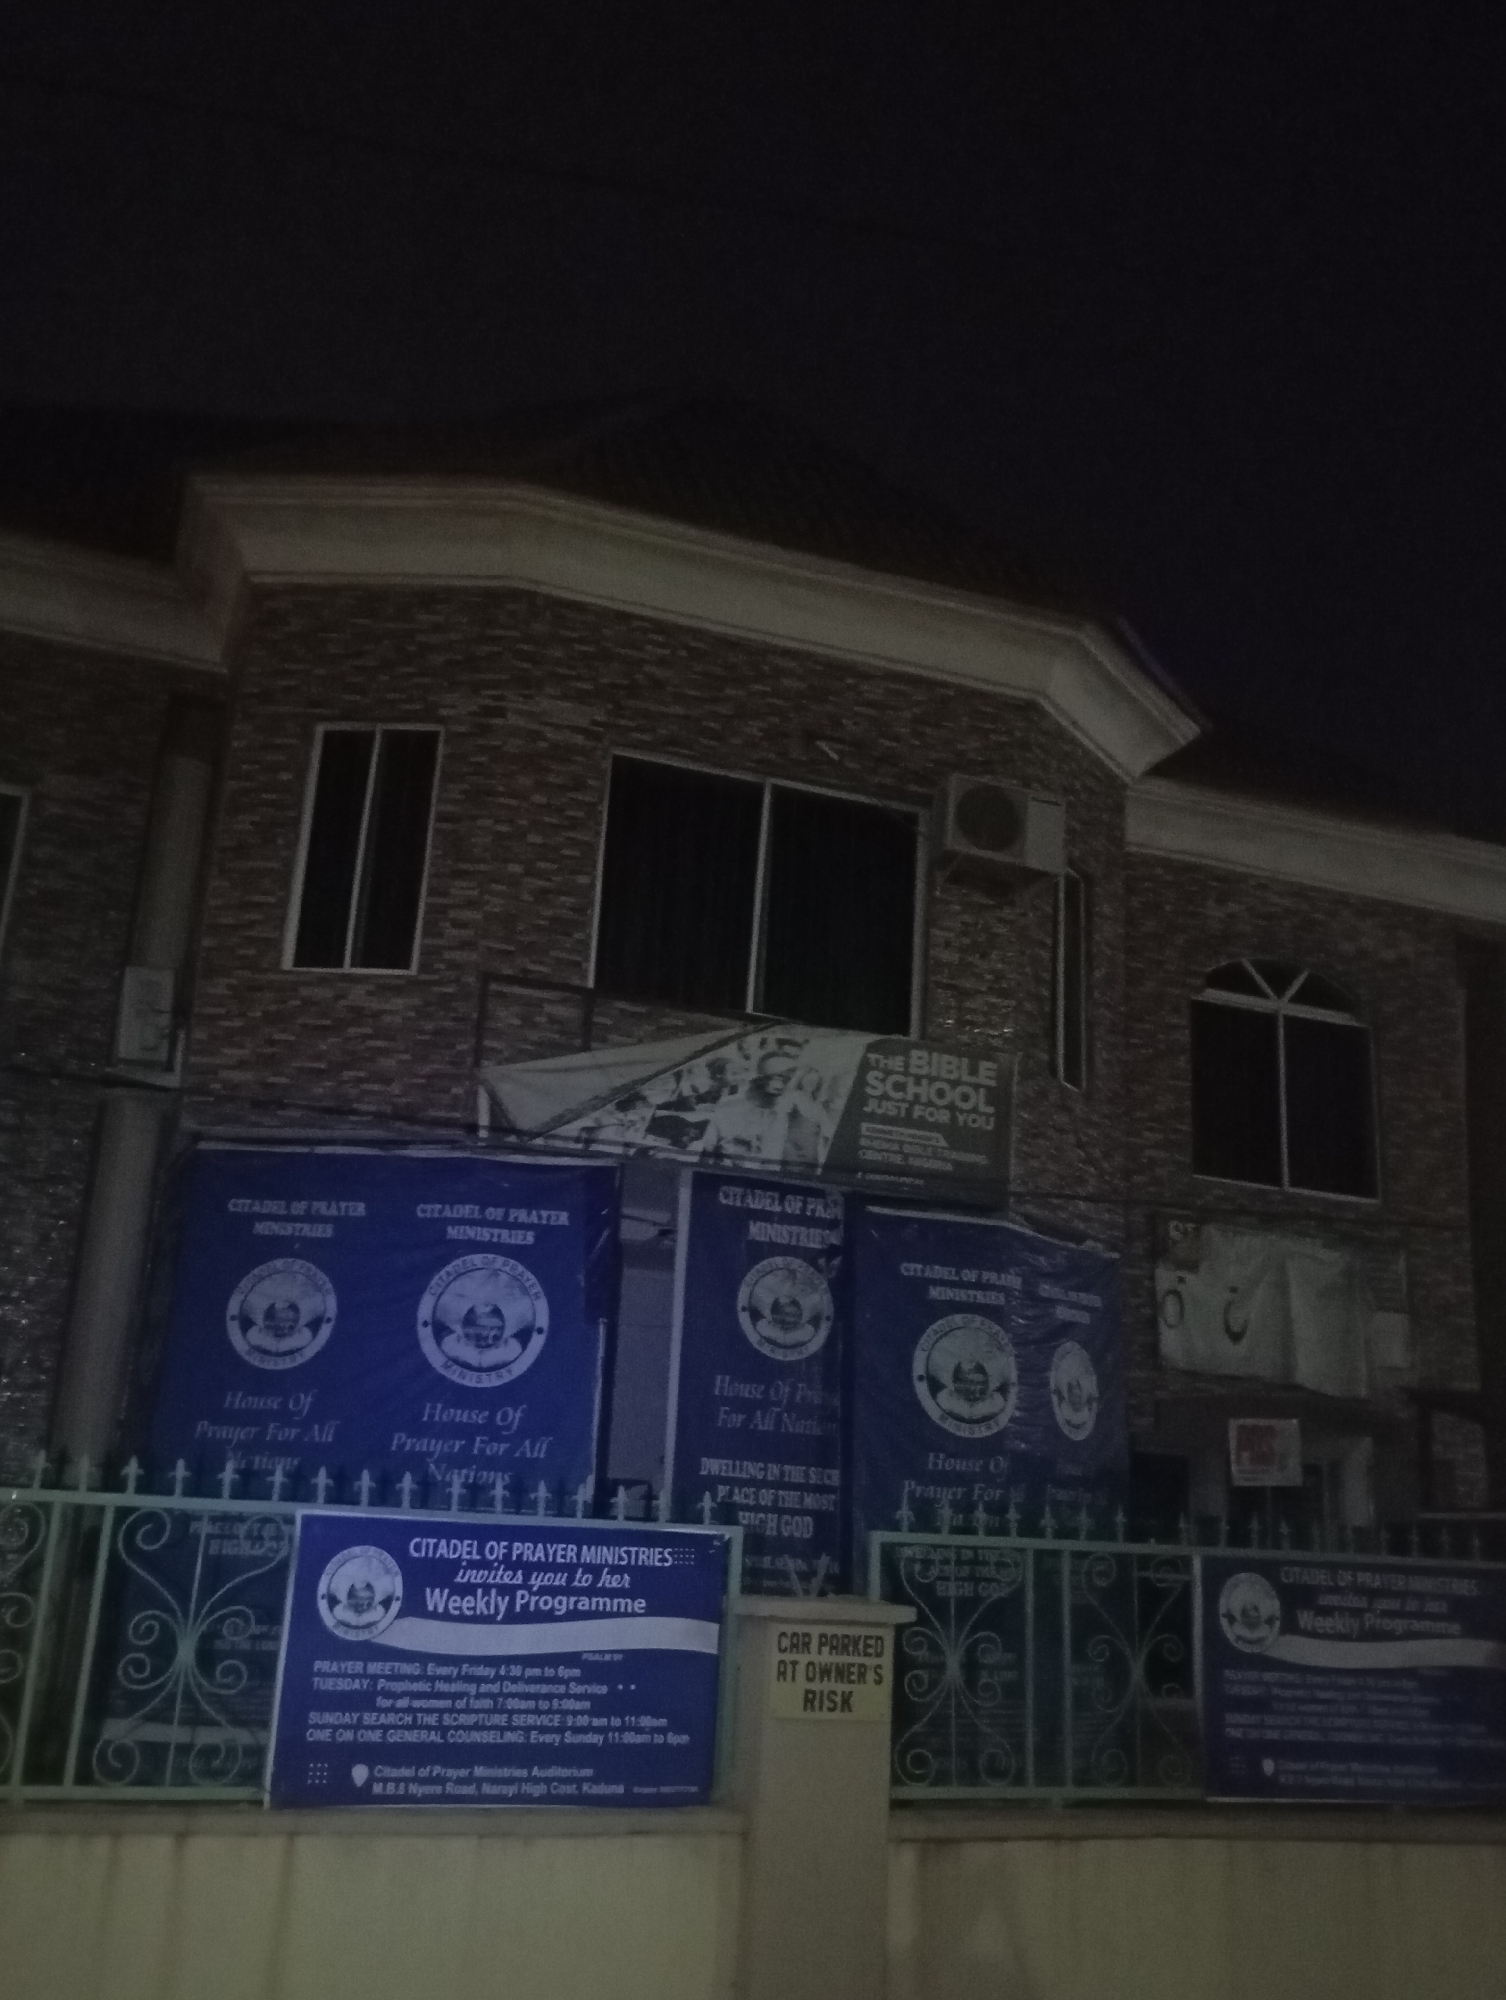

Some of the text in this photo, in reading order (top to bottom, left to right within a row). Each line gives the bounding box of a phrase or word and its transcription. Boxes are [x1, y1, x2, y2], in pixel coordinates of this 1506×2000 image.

[866, 1050, 998, 1086] THE BIBLE
[865, 1070, 995, 1113] SCHOOL
[862, 1098, 994, 1130] JUST FOR YOU
[719, 1185, 782, 1212] CITADEL
[784, 1194, 803, 1214] OF
[416, 1203, 569, 1225] CITADEL OF PRAYER
[446, 1225, 535, 1245] MINISTRIES
[714, 1375, 765, 1399] House
[289, 1389, 318, 1420] Of
[423, 1402, 527, 1435] House Of
[717, 1406, 746, 1428] For
[266, 1422, 302, 1441] For
[304, 1420, 340, 1442] All
[391, 1432, 554, 1462] Prayer For All
[700, 1457, 766, 1479] DWELLING
[767, 1463, 782, 1480] IN
[783, 1464, 806, 1484] THE
[758, 1488, 775, 1506] OF
[777, 1490, 801, 1508] THE
[972, 1483, 1004, 1501] For
[780, 1515, 814, 1539] GOD
[408, 1537, 674, 1567] CITADEL OF PRAYER MINISTRIES
[454, 1560, 631, 1592] invites you to her
[425, 1587, 647, 1621] Weekly Programme
[1297, 1610, 1360, 1638] Weekly
[778, 1631, 884, 1658] CAR PARKED
[313, 1660, 364, 1674] PRAYER
[427, 1663, 459, 1679] Every
[460, 1663, 497, 1680] Friday
[524, 1667, 542, 1679] pm
[544, 1665, 556, 1678] to
[557, 1665, 581, 1679] 6pm
[777, 1659, 799, 1682] AT
[312, 1677, 373, 1691] TUESDAY:
[377, 1678, 432, 1693] Prophetic
[478, 1681, 500, 1694] and
[502, 1680, 566, 1694] Deliverance
[568, 1681, 608, 1695] Service
[803, 1688, 853, 1713] RISK
[308, 1711, 360, 1725] SUNDAY
[362, 1712, 413, 1726] SEARCH
[416, 1713, 440, 1726] THE
[442, 1713, 508, 1726] SCRIPTURE
[610, 1715, 622, 1727] to
[306, 1728, 333, 1742] ONE
[335, 1729, 355, 1743] ON
[357, 1729, 383, 1743] ONE
[386, 1729, 444, 1743] GENERAL
[530, 1731, 562, 1746] Every
[564, 1731, 604, 1747] Sunday
[653, 1732, 665, 1744] to
[417, 1765, 431, 1777] of
[432, 1765, 472, 1780] Prayer
[531, 1766, 594, 1778] Auditorium
